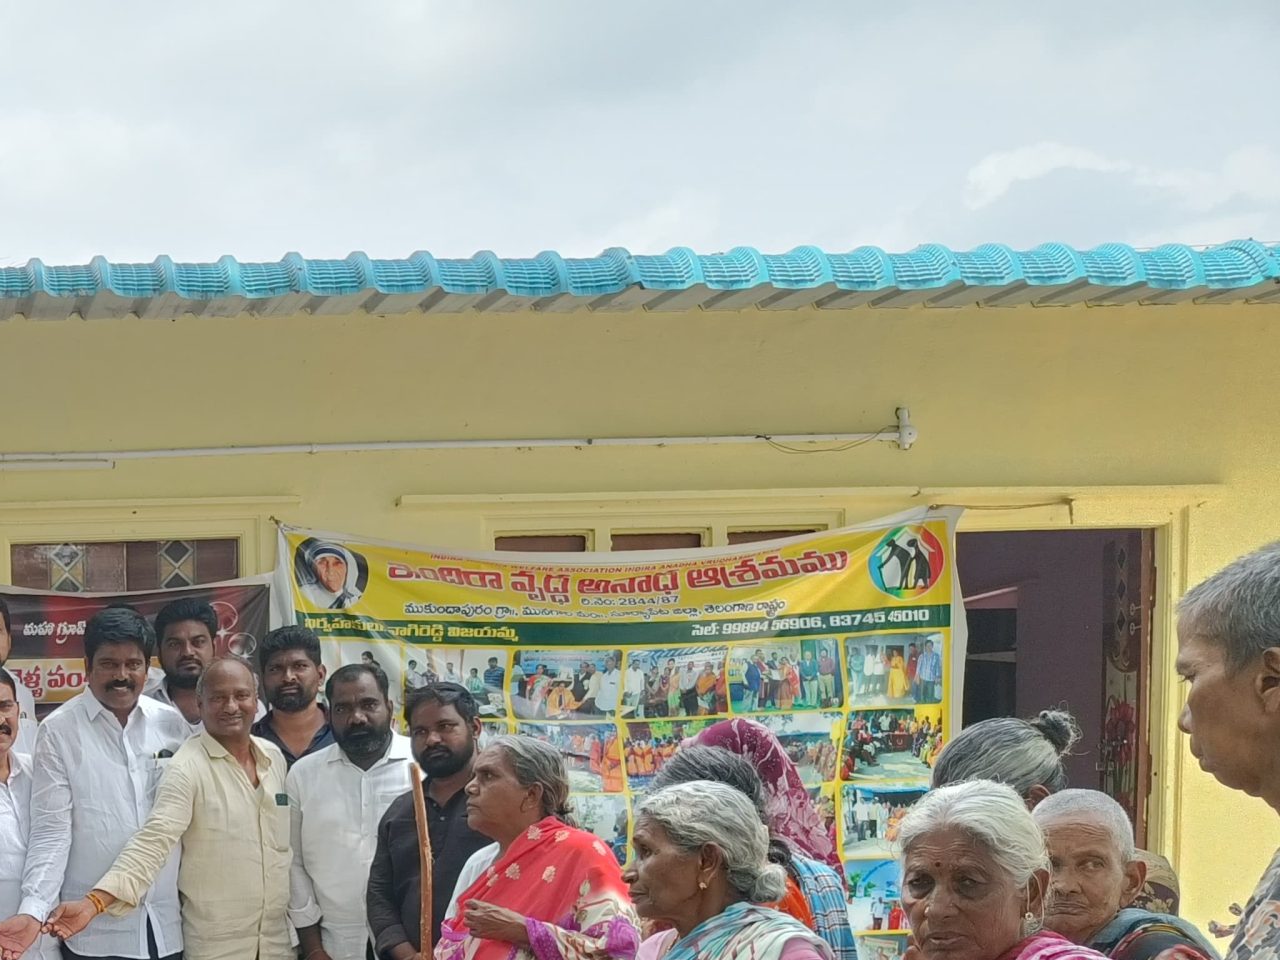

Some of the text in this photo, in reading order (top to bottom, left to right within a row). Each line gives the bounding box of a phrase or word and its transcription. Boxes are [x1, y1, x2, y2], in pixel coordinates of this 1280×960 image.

[558, 566, 622, 574] ASSOCIATION
[659, 561, 697, 570] ANADHA
[510, 570, 570, 604] వృద్ధ
[686, 550, 848, 588] ఆశ్రమము
[619, 595, 679, 606] 2844/87
[404, 602, 492, 617] ముకుందాపురం
[704, 603, 754, 615] తెలంగాణ
[722, 621, 769, 635] 99894
[770, 616, 826, 632] 56906,
[886, 609, 930, 622] 45010
[447, 626, 519, 642] విజయమ్మ
